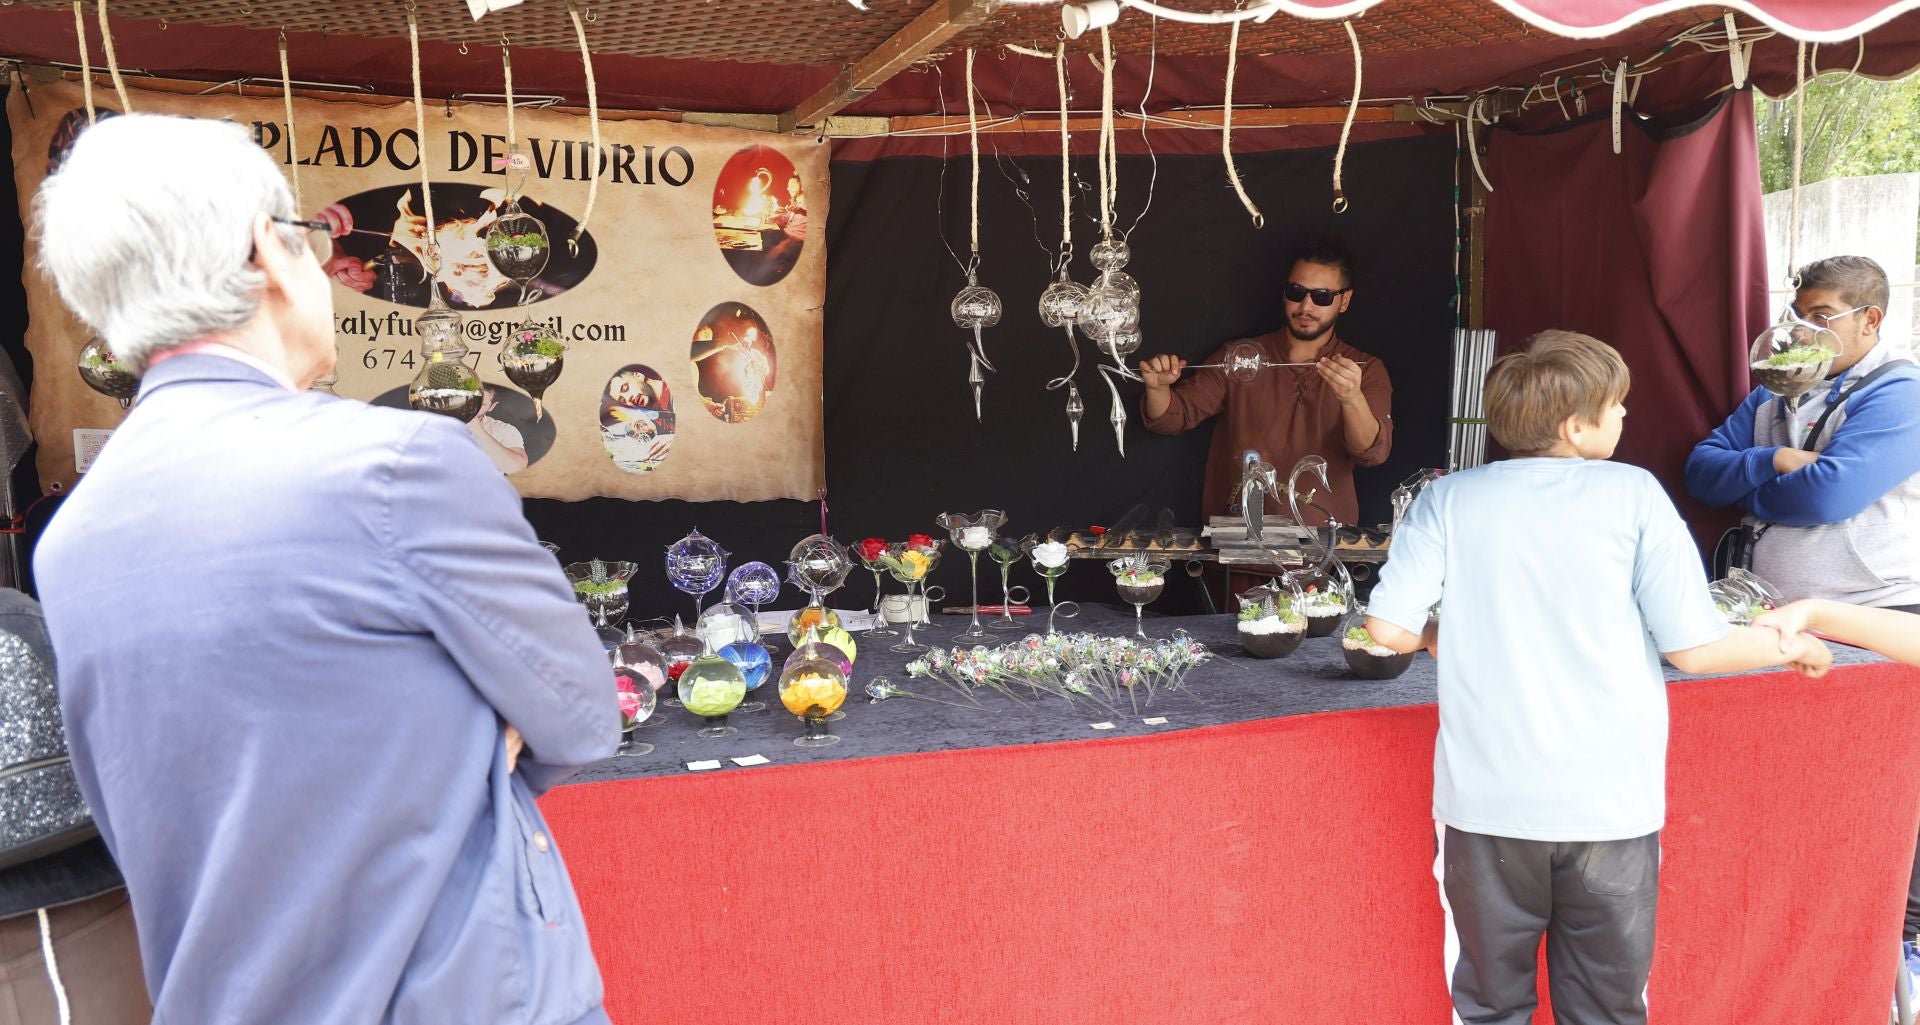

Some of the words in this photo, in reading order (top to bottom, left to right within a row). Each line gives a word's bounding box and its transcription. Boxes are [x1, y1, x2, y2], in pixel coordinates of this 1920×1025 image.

[220, 118, 421, 171] PLADO
[448, 130, 506, 175] DE
[527, 137, 695, 187] VIDRIO
[363, 348, 416, 370] 674
